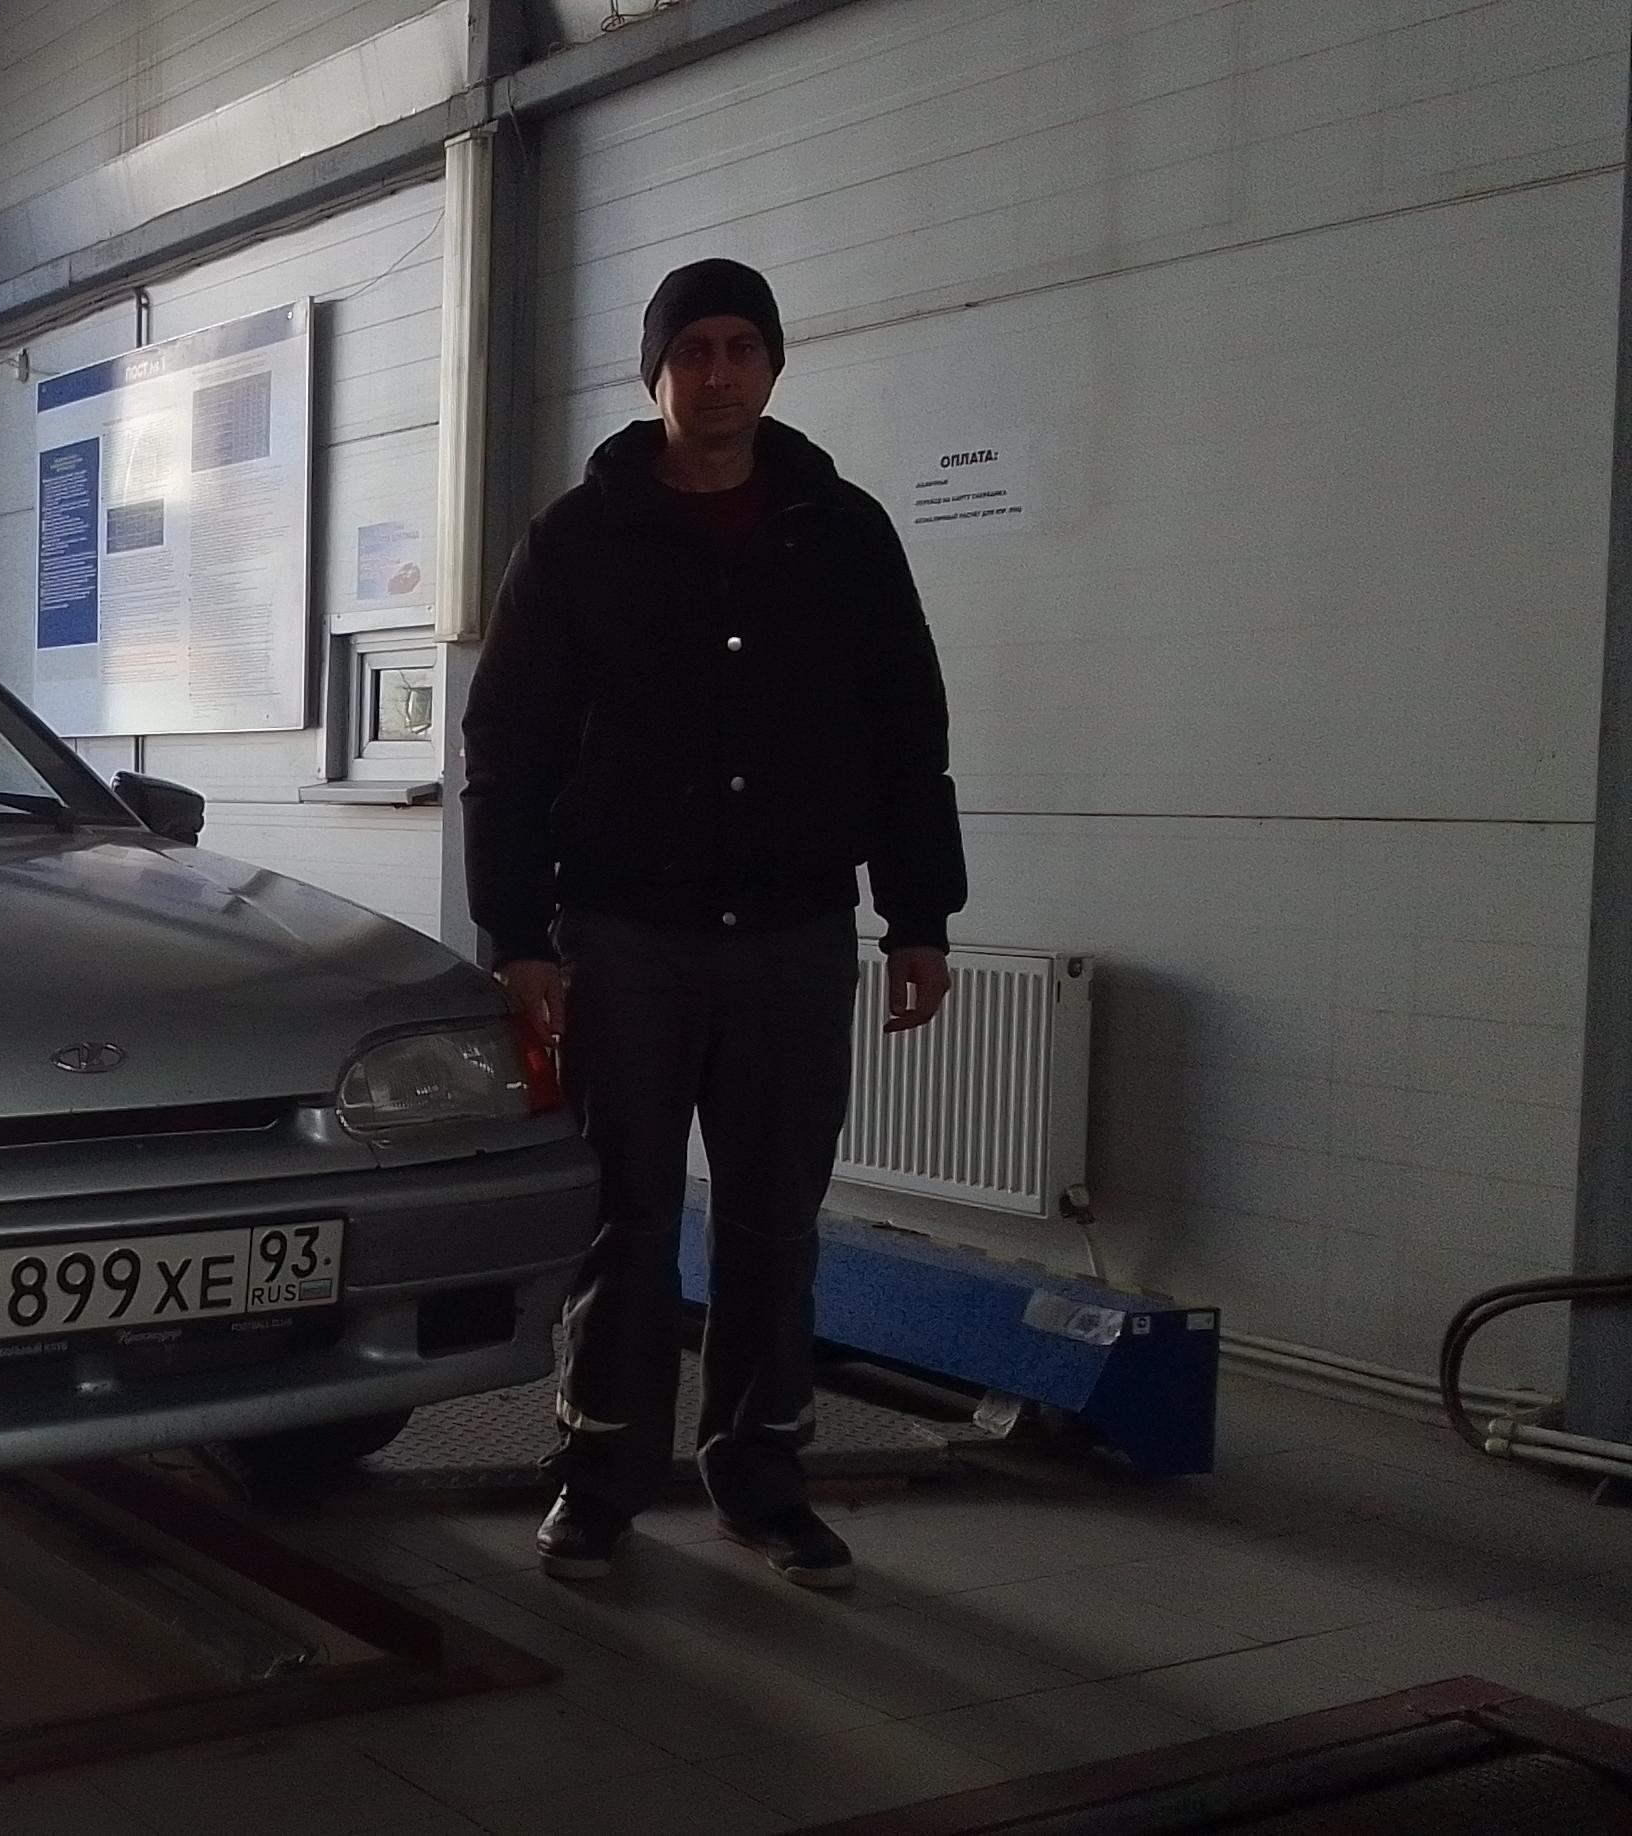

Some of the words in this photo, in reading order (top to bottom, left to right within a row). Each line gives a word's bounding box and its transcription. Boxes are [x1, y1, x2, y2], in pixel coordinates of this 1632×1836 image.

[940, 449, 999, 468] ОПЛАТА:
[259, 1226, 320, 1283] 93
[251, 1283, 297, 1305] RUS
